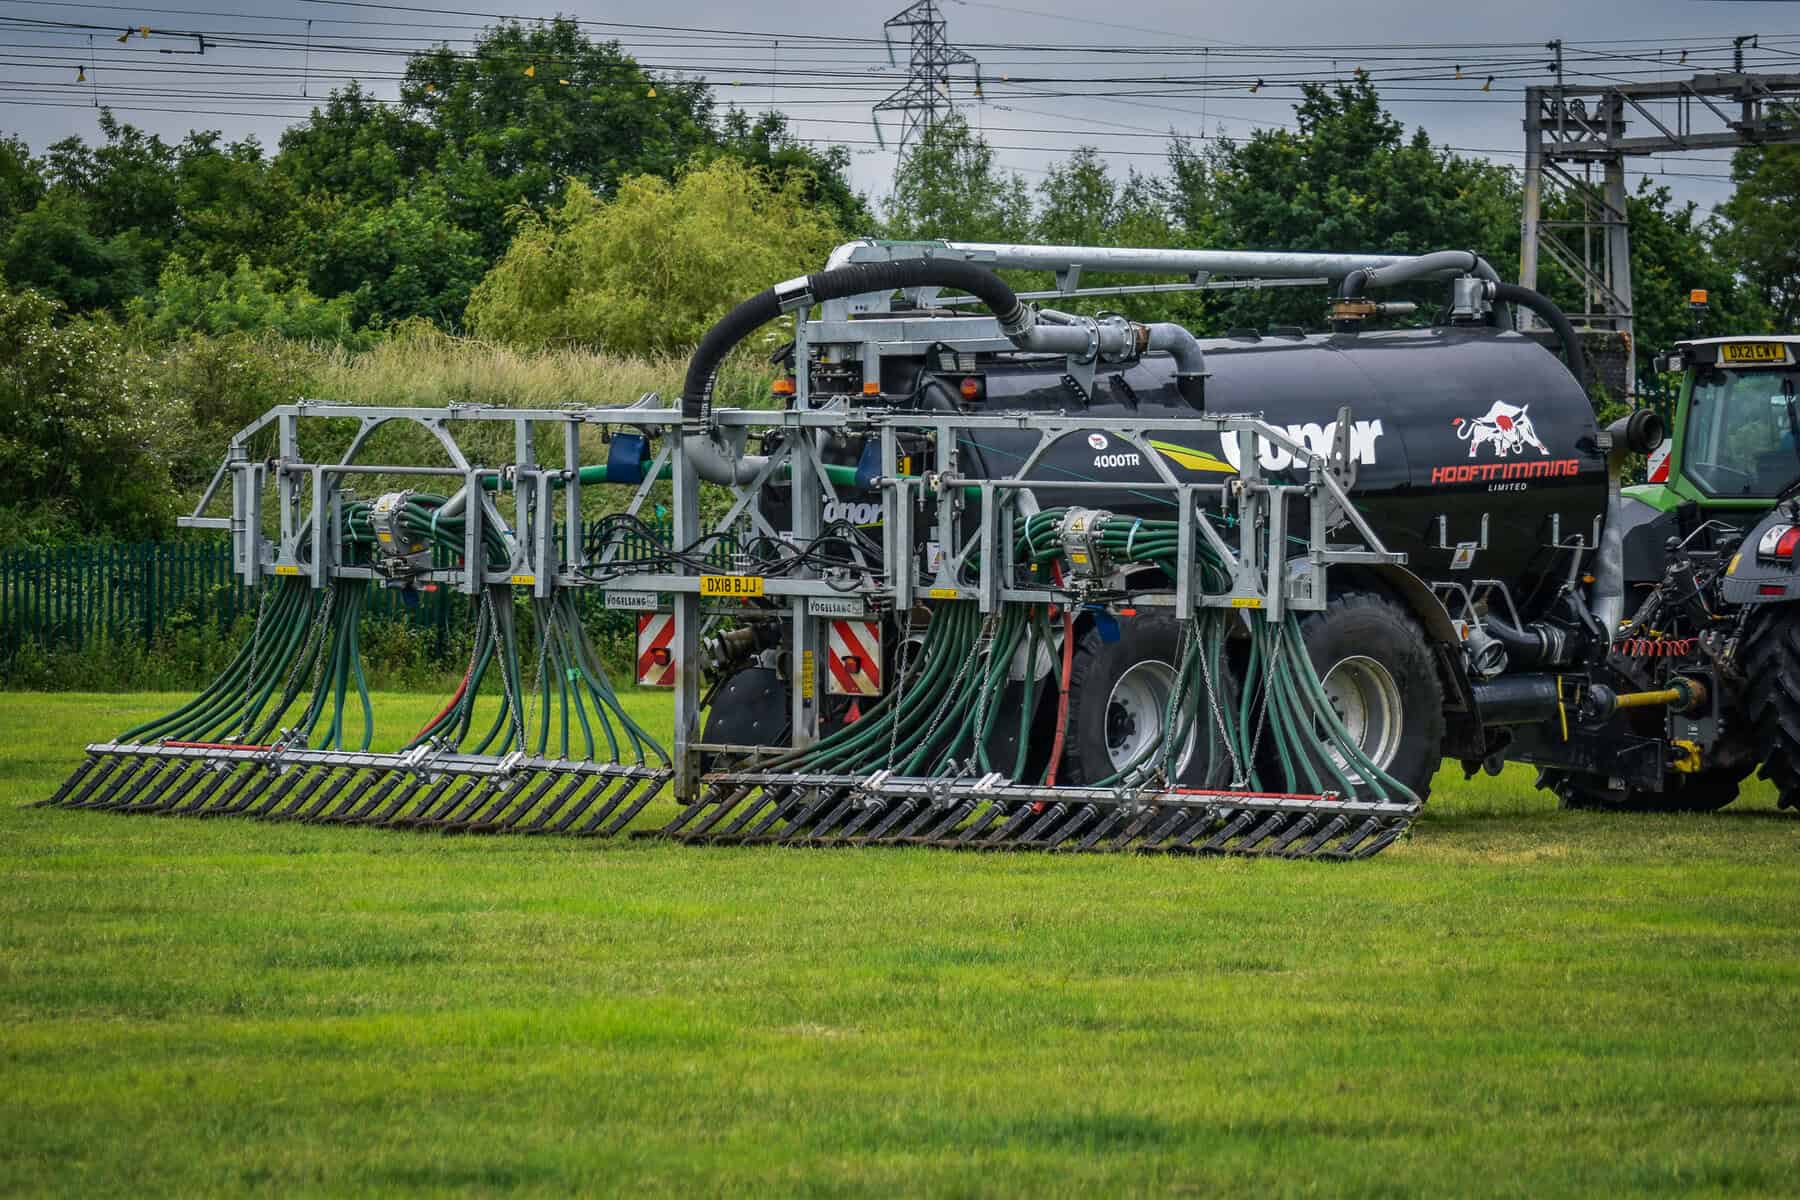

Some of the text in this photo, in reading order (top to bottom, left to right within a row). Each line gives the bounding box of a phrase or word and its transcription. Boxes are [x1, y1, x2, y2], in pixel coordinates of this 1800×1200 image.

[1093, 453, 1140, 468] 4000TR
[1431, 459, 1580, 484] HOOFTRIMMING
[1488, 482, 1527, 492] LIMITED
[707, 578, 757, 593] DX18 BJJ
